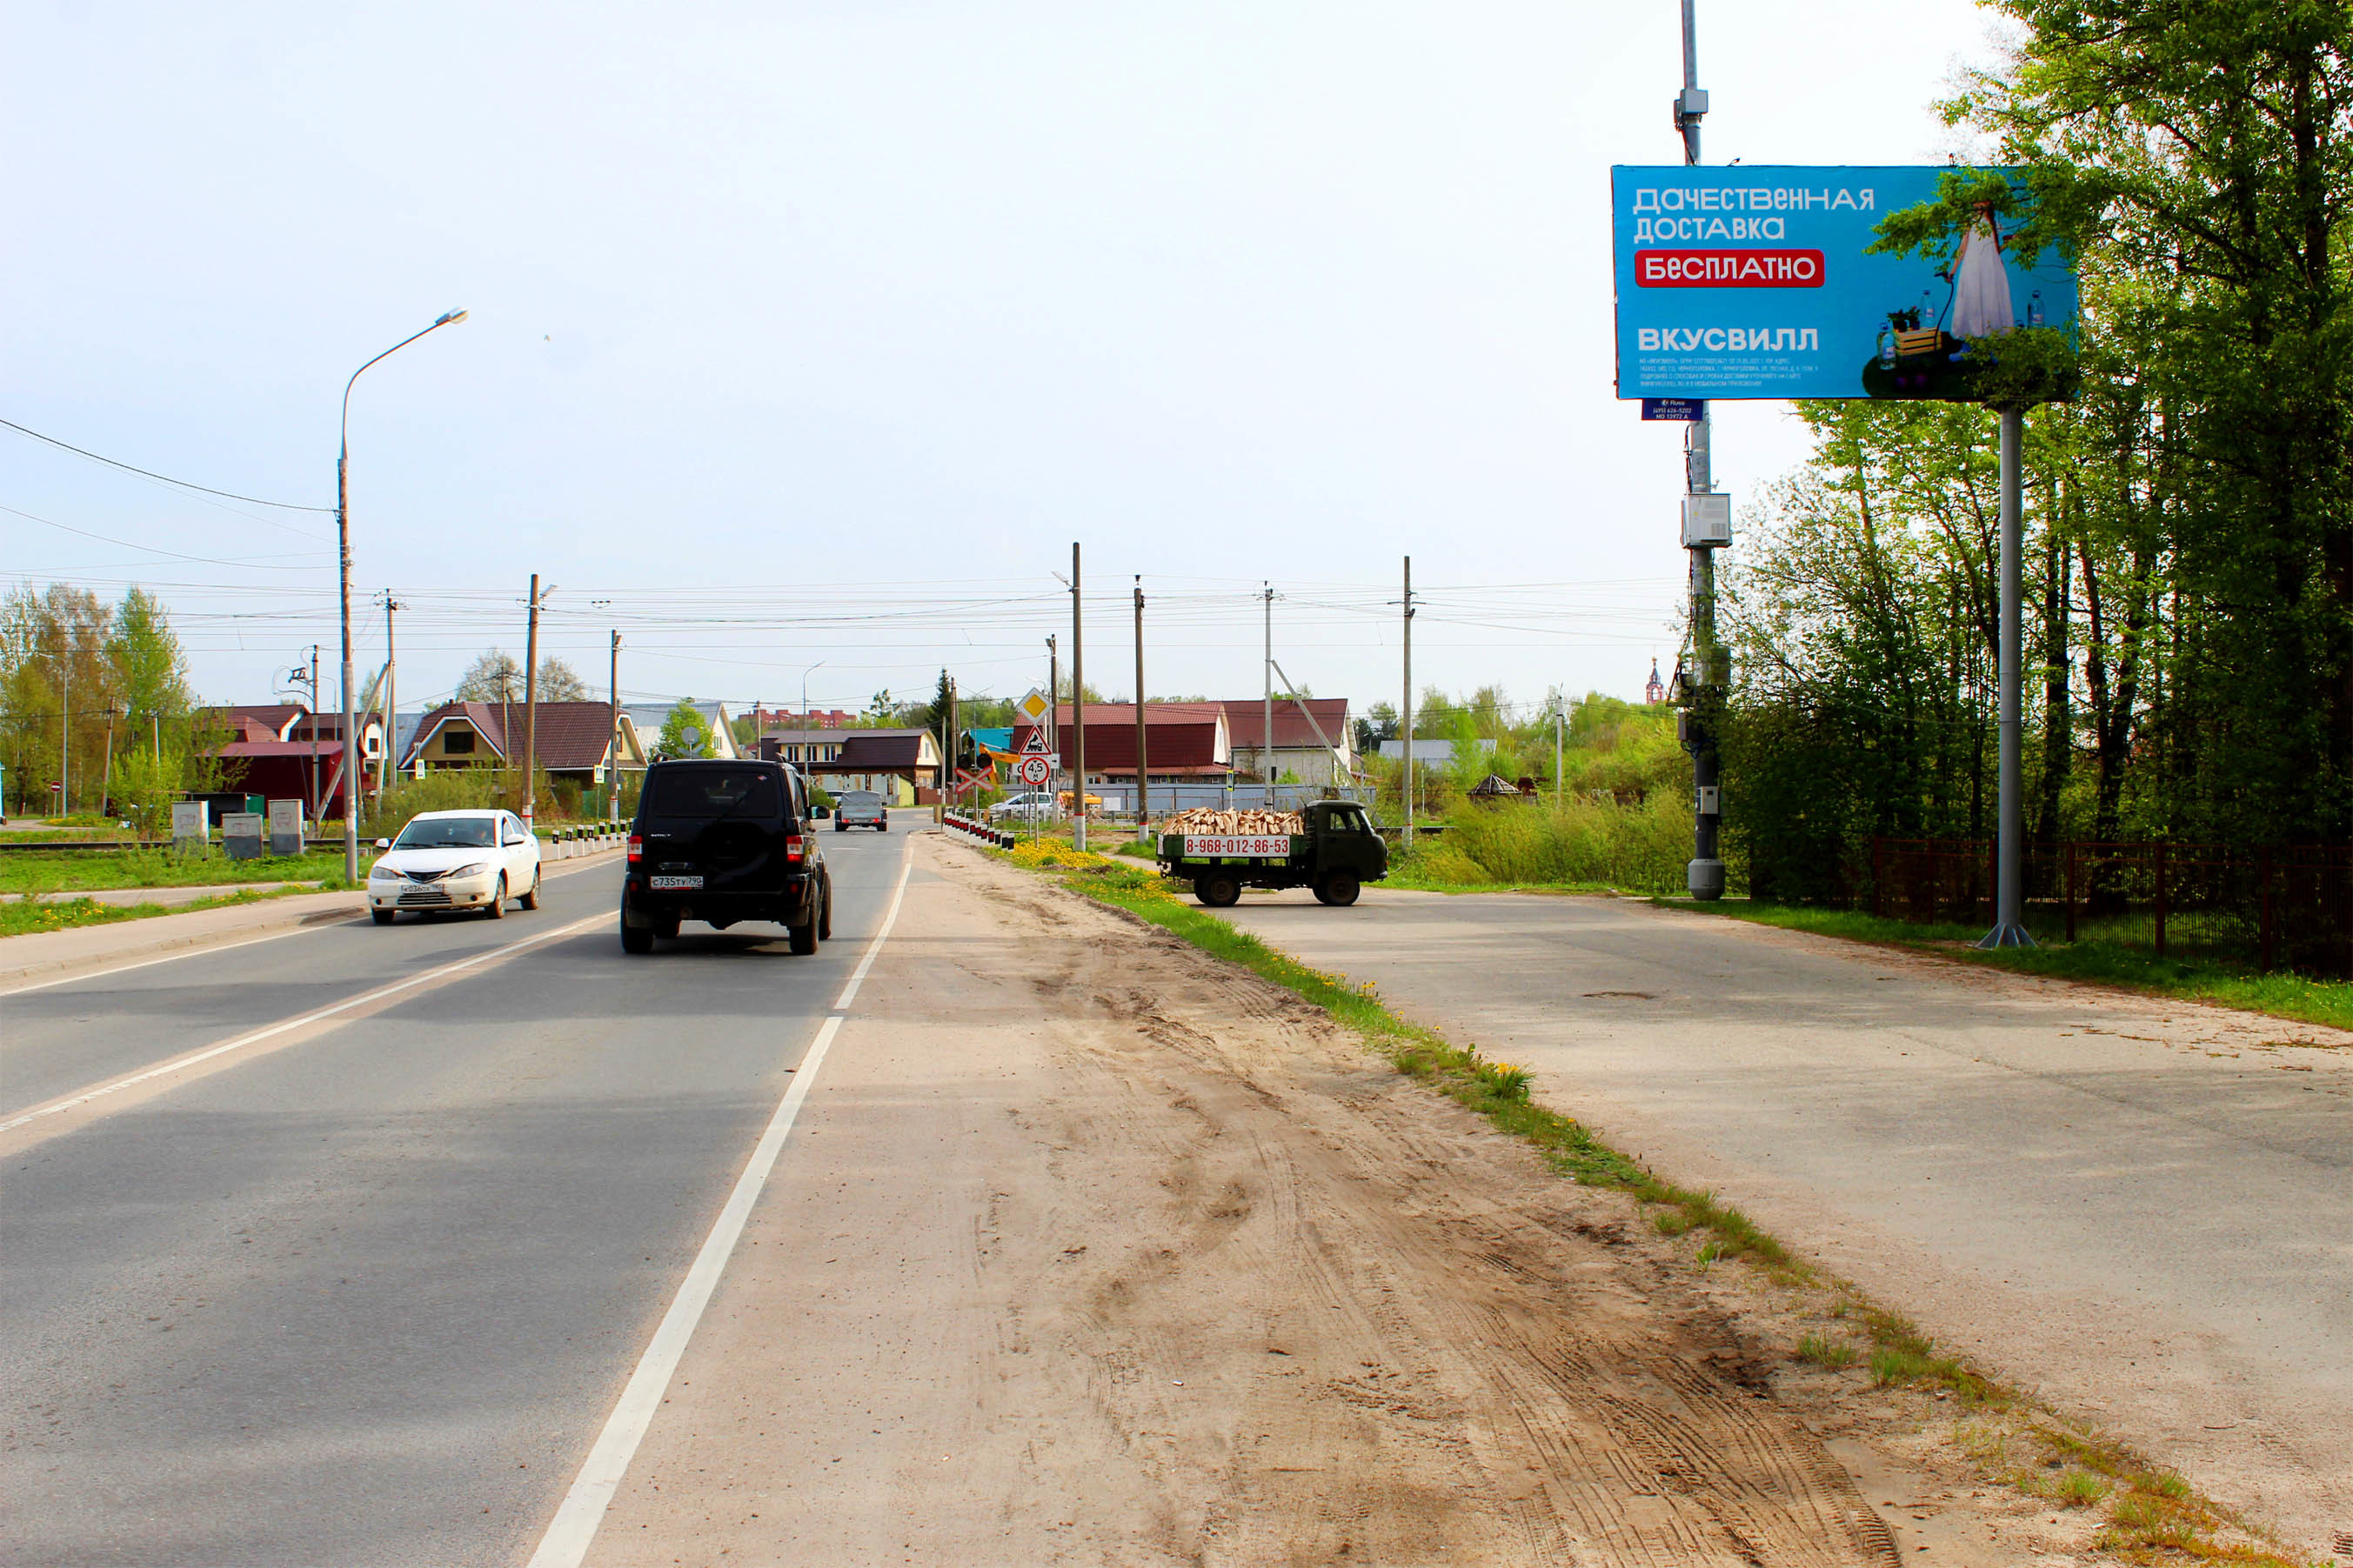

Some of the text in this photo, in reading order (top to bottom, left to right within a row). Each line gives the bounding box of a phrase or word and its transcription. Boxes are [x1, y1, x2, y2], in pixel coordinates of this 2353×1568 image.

[1634, 217, 1785, 244] ДОСТАВКА
[1645, 257, 1816, 279] БЕСПЛАТНО
[1638, 328, 1818, 350] ВКУСВИЛЛ
[1186, 838, 1288, 853] 8-968-012-86-53
